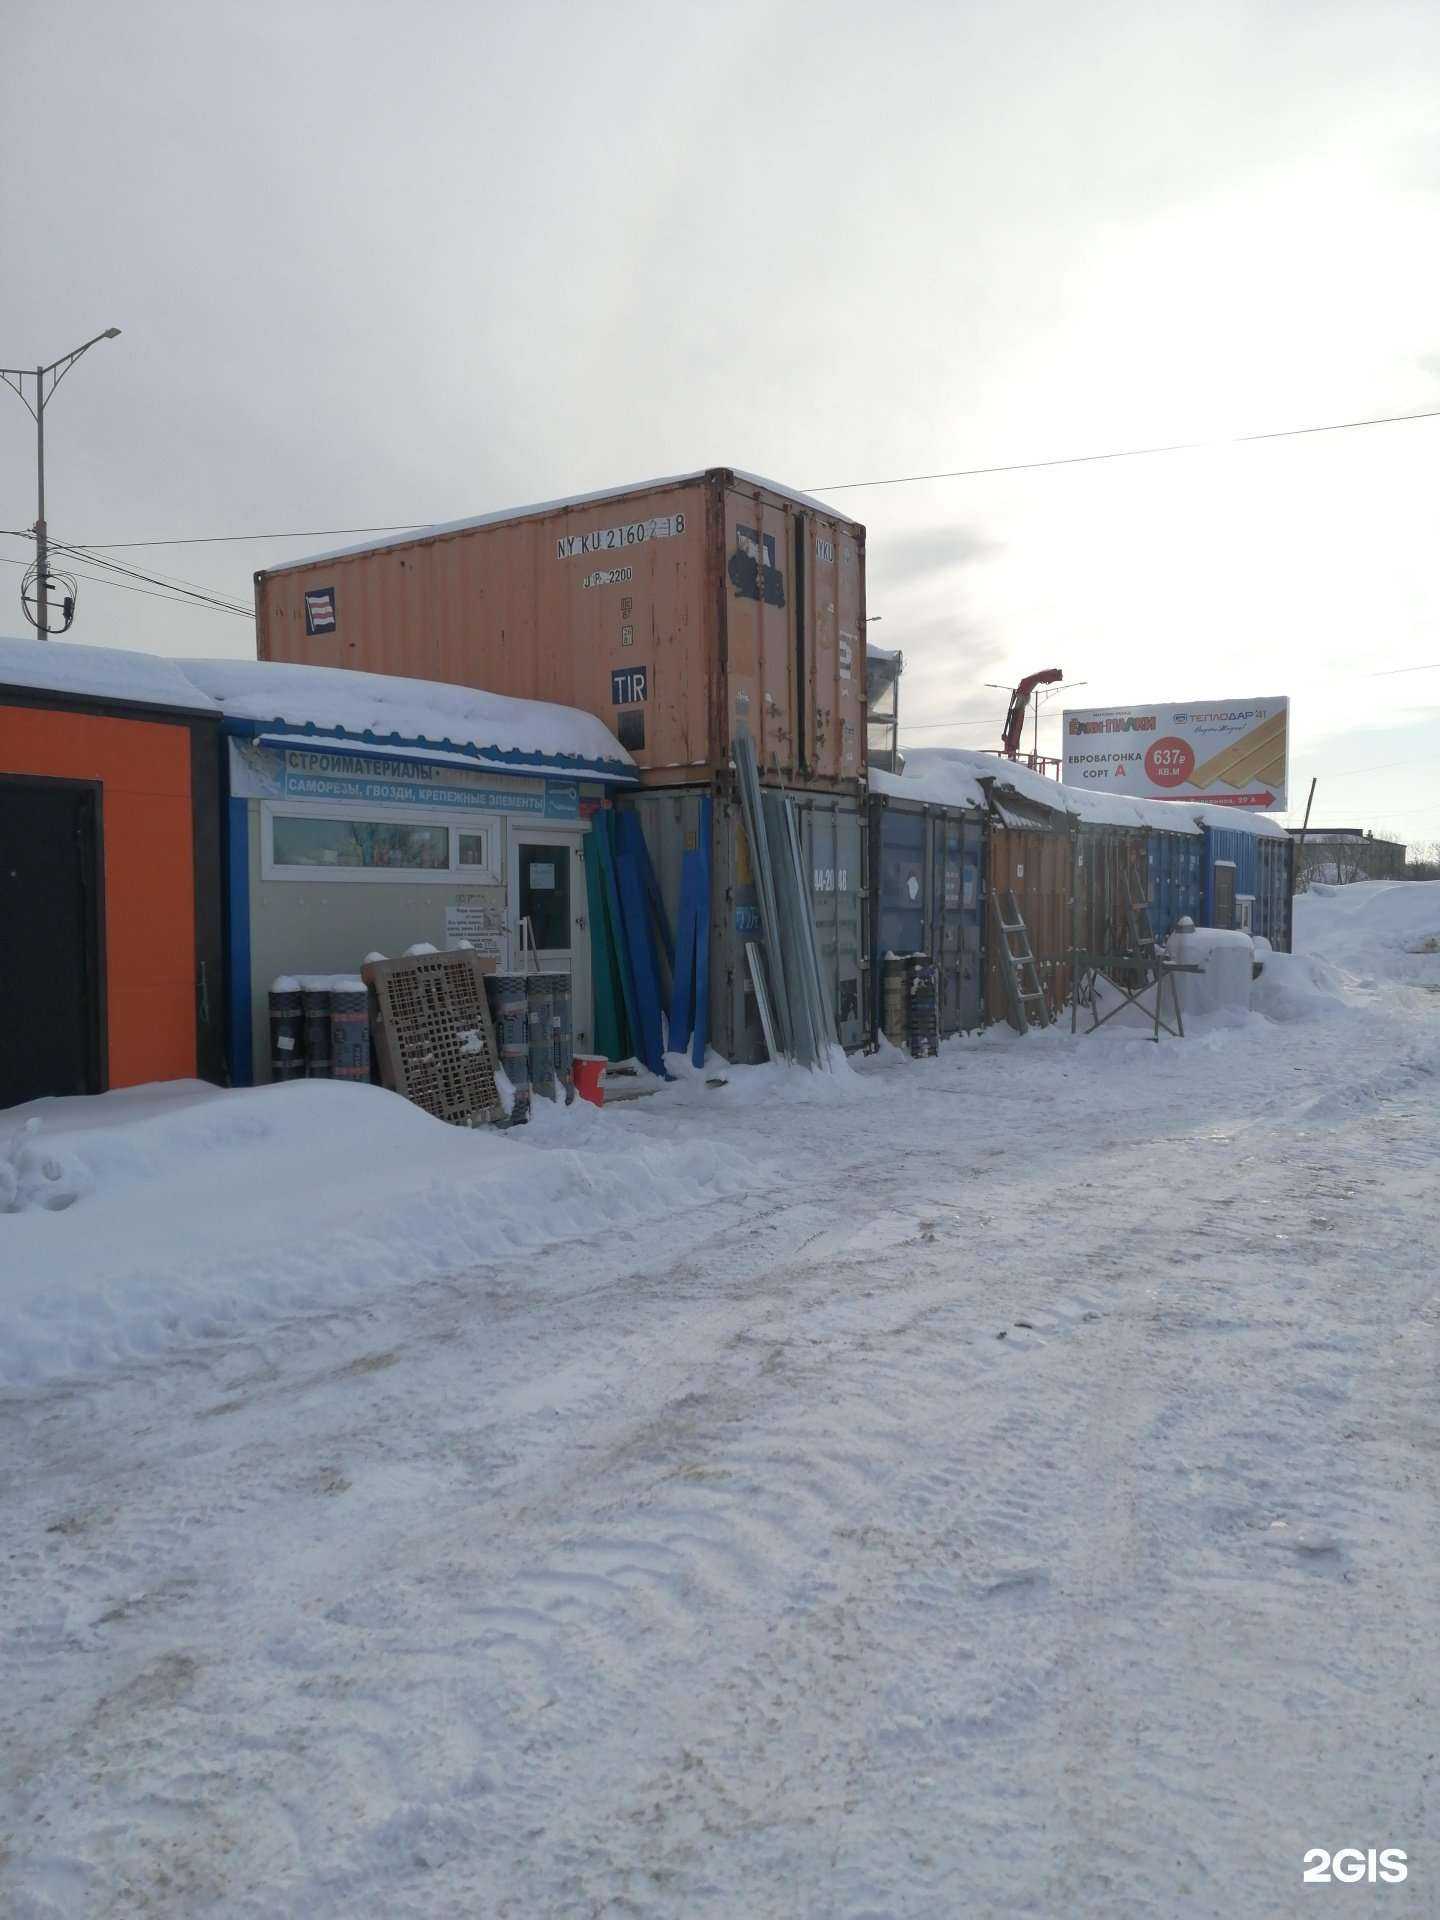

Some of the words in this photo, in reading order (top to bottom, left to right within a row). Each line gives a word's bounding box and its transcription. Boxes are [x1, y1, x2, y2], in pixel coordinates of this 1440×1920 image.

[614, 675, 645, 704] TIR
[1190, 711, 1254, 723] ТЕПЛОДАР
[1068, 752, 1143, 764] ЕВРОВАГОНКА
[1082, 769, 1109, 779] СОРТ
[1114, 764, 1126, 777] А
[420, 788, 487, 806] КРЕПЕЖНЫЕ
[488, 795, 544, 809] ЭЛЕМЕНТЫ
